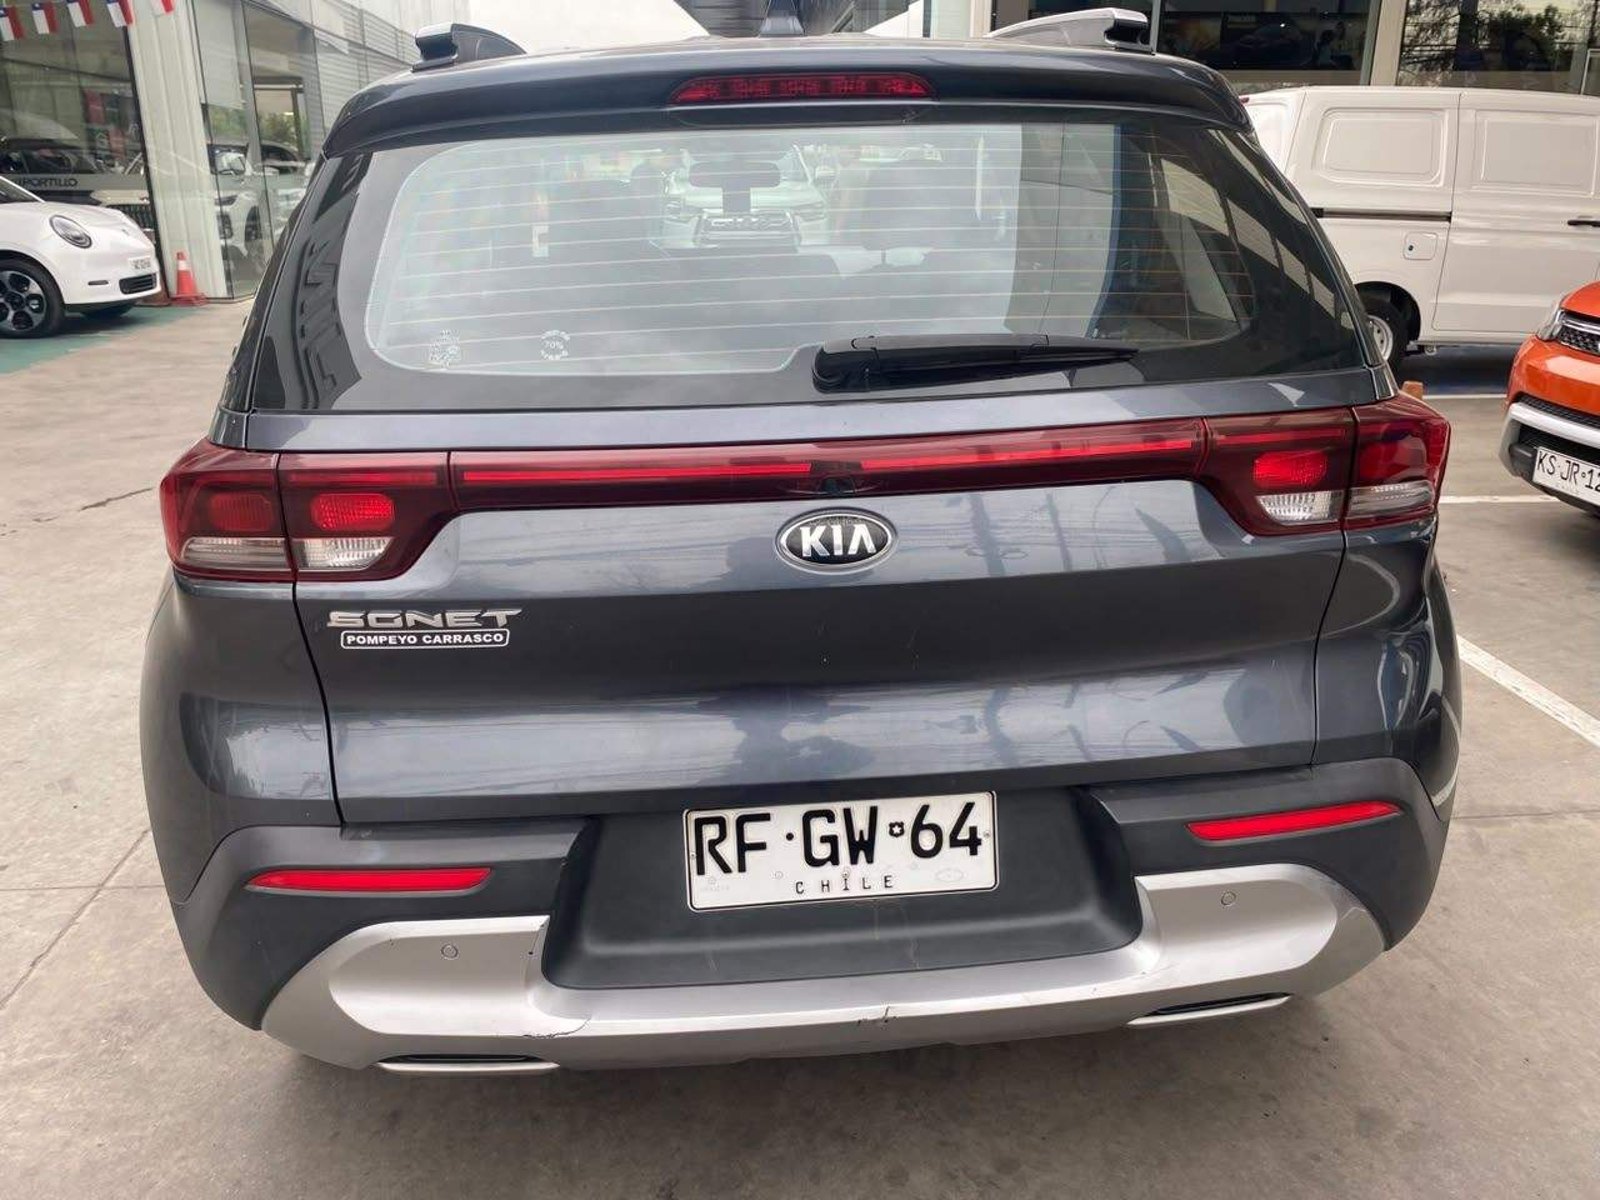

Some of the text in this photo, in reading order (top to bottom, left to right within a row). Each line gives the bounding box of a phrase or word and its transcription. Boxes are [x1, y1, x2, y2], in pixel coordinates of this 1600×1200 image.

[800, 523, 877, 557] KIA
[327, 608, 522, 627] SONET
[346, 633, 504, 645] POMPEYO CARRASCO
[795, 875, 893, 894] CHILE
